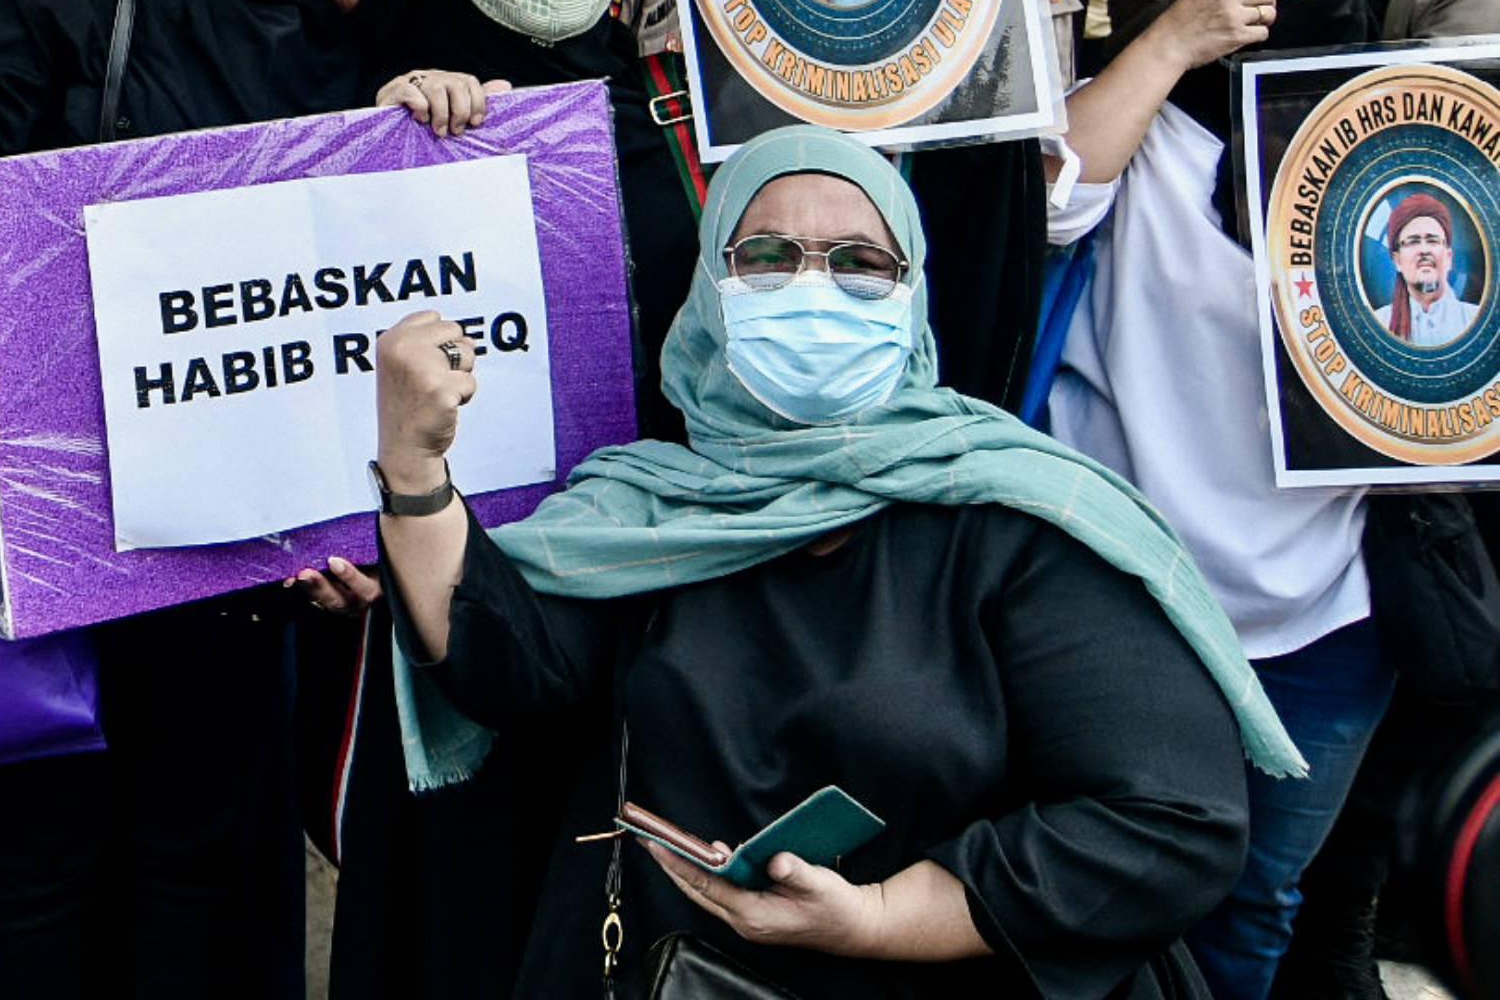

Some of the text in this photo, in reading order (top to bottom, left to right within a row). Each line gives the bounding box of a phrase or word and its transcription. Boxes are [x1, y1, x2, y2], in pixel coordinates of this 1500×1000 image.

[762, 41, 942, 102] KRIMINALISASI
[1290, 92, 1500, 267] BEBASKAN IB HRS DAN KAWA
[159, 252, 477, 335] BEBASKAN
[133, 311, 530, 409] HABIB REQ
[1300, 304, 1500, 438] STOP KRIMINALISAS
